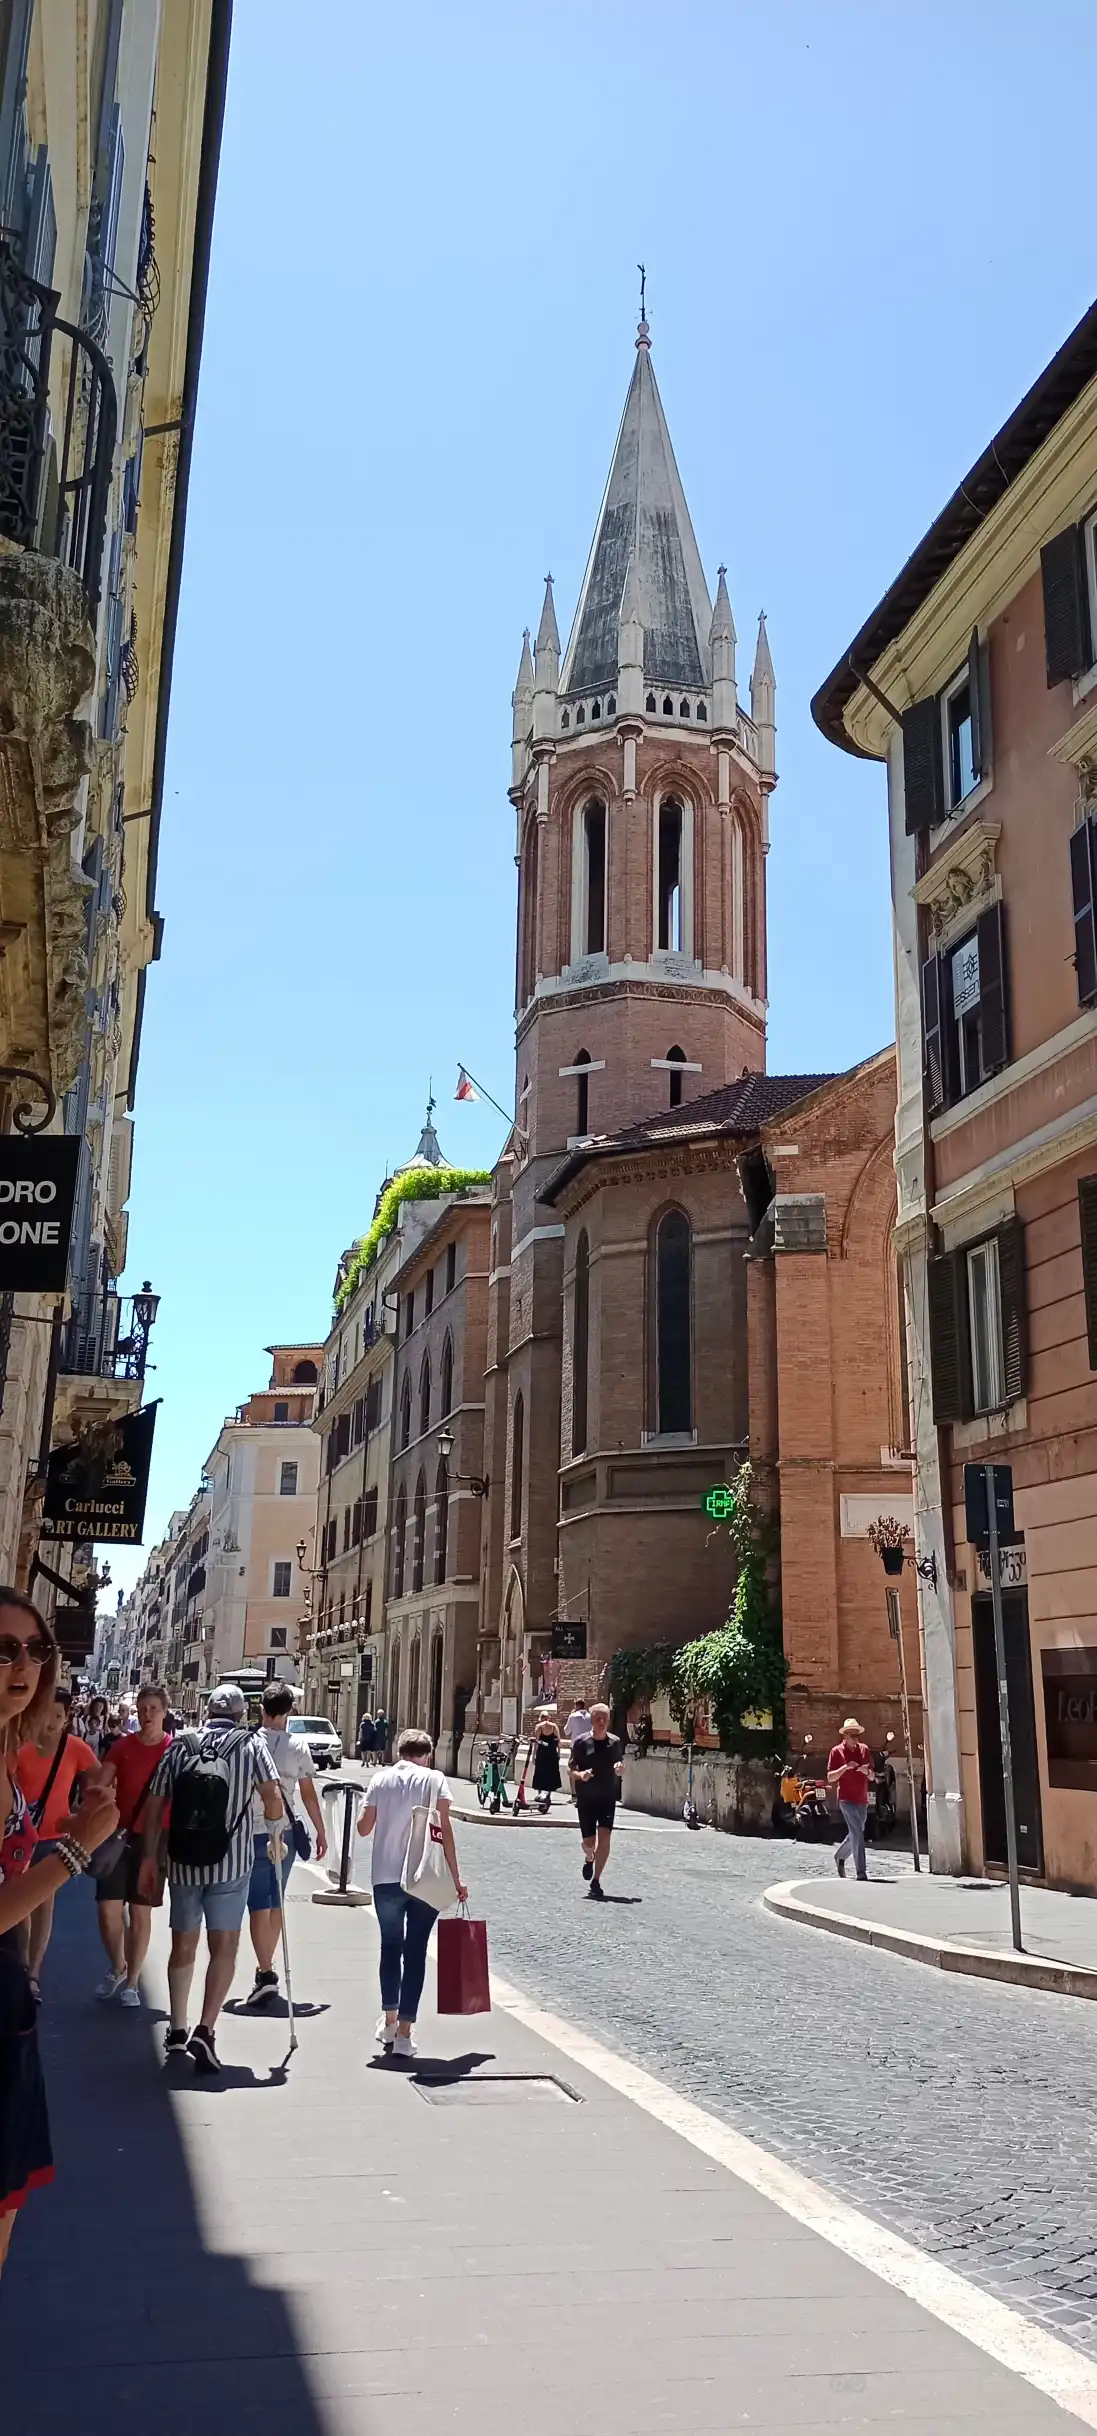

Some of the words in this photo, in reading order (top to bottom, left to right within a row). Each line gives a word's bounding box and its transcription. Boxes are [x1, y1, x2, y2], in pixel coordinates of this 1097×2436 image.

[0, 1180, 57, 1204] DRO
[0, 1221, 61, 1245] ONE
[64, 1498, 125, 1515] Carlucci
[77, 1521, 139, 1538] GALLERY
